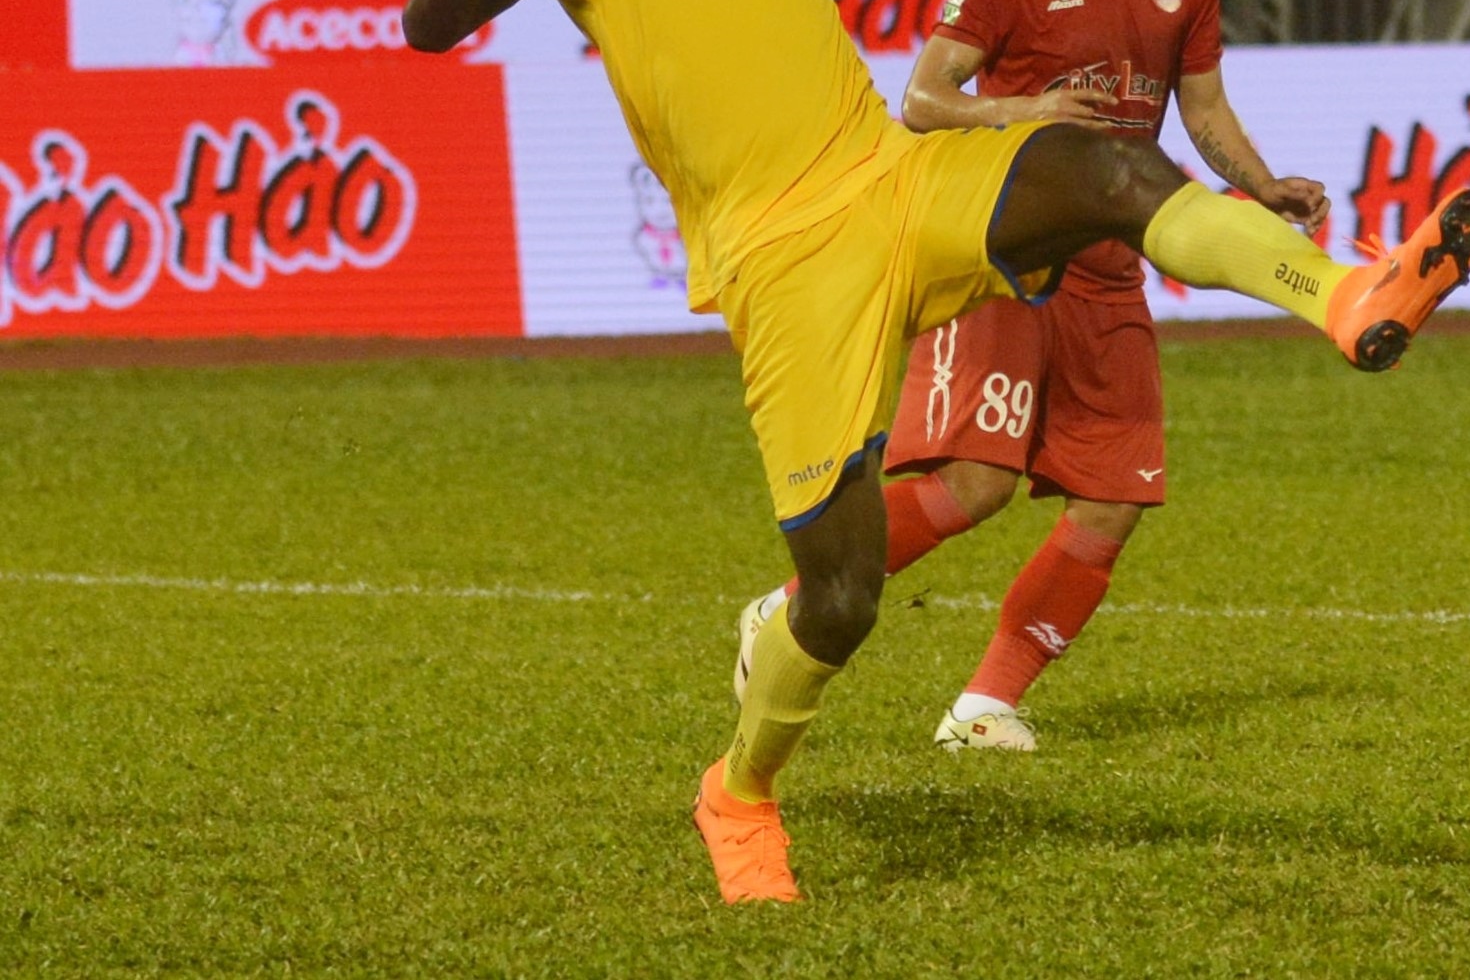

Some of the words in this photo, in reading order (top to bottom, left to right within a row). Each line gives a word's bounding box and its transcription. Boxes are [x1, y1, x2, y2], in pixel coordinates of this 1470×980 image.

[1275, 262, 1320, 297] mitre
[975, 372, 1034, 439] 89
[787, 456, 834, 488] mitre
